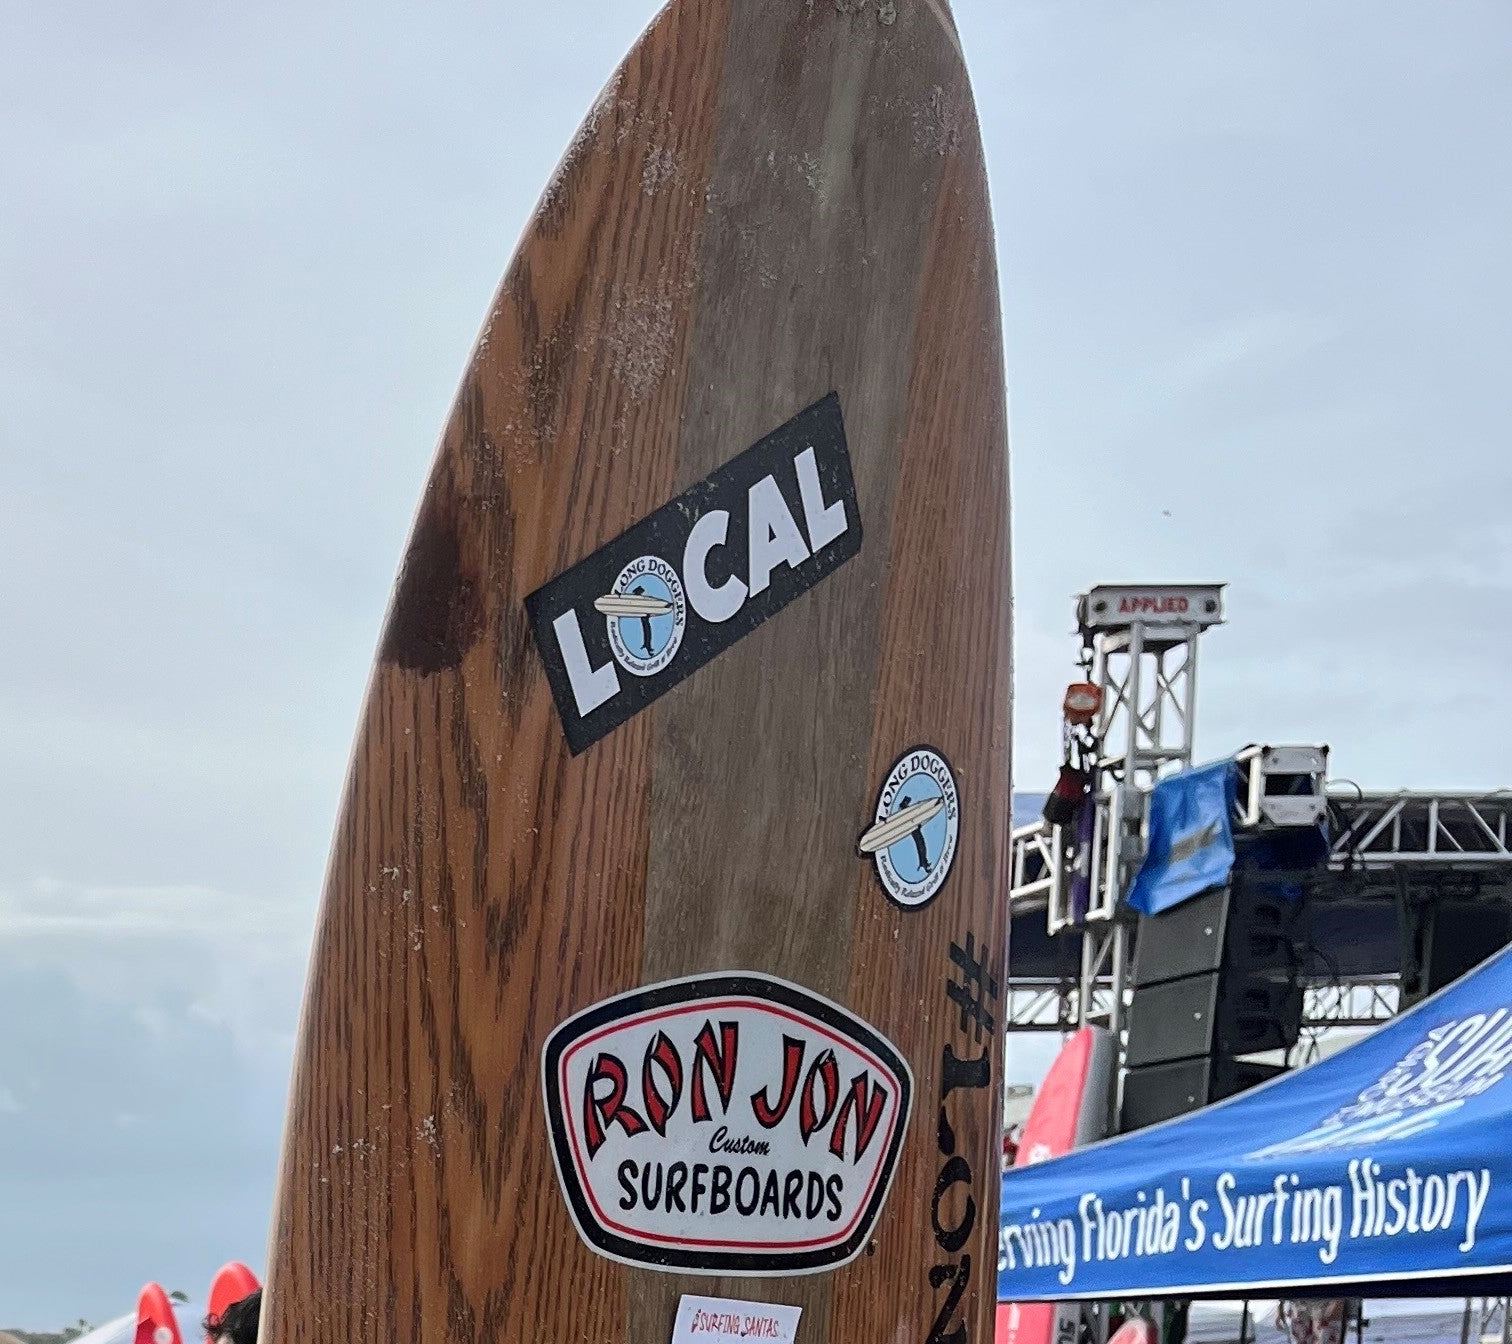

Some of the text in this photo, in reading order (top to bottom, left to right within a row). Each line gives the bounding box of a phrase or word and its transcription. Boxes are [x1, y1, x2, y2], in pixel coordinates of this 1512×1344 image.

[553, 446, 848, 718] LOCAL
[614, 559, 684, 627] LONG DOGGERS
[1119, 596, 1188, 614] APPLIED
[878, 755, 957, 824] LONG DOGGERS
[584, 1019, 888, 1165] RON JON
[709, 1126, 771, 1155] Custom
[618, 1159, 843, 1221] SURFBOARDS
[1080, 1177, 1208, 1262] Florida's
[1213, 1172, 1342, 1264] Surfing
[1348, 1157, 1490, 1252] History
[699, 1312, 779, 1338] SURFING SANTAS
